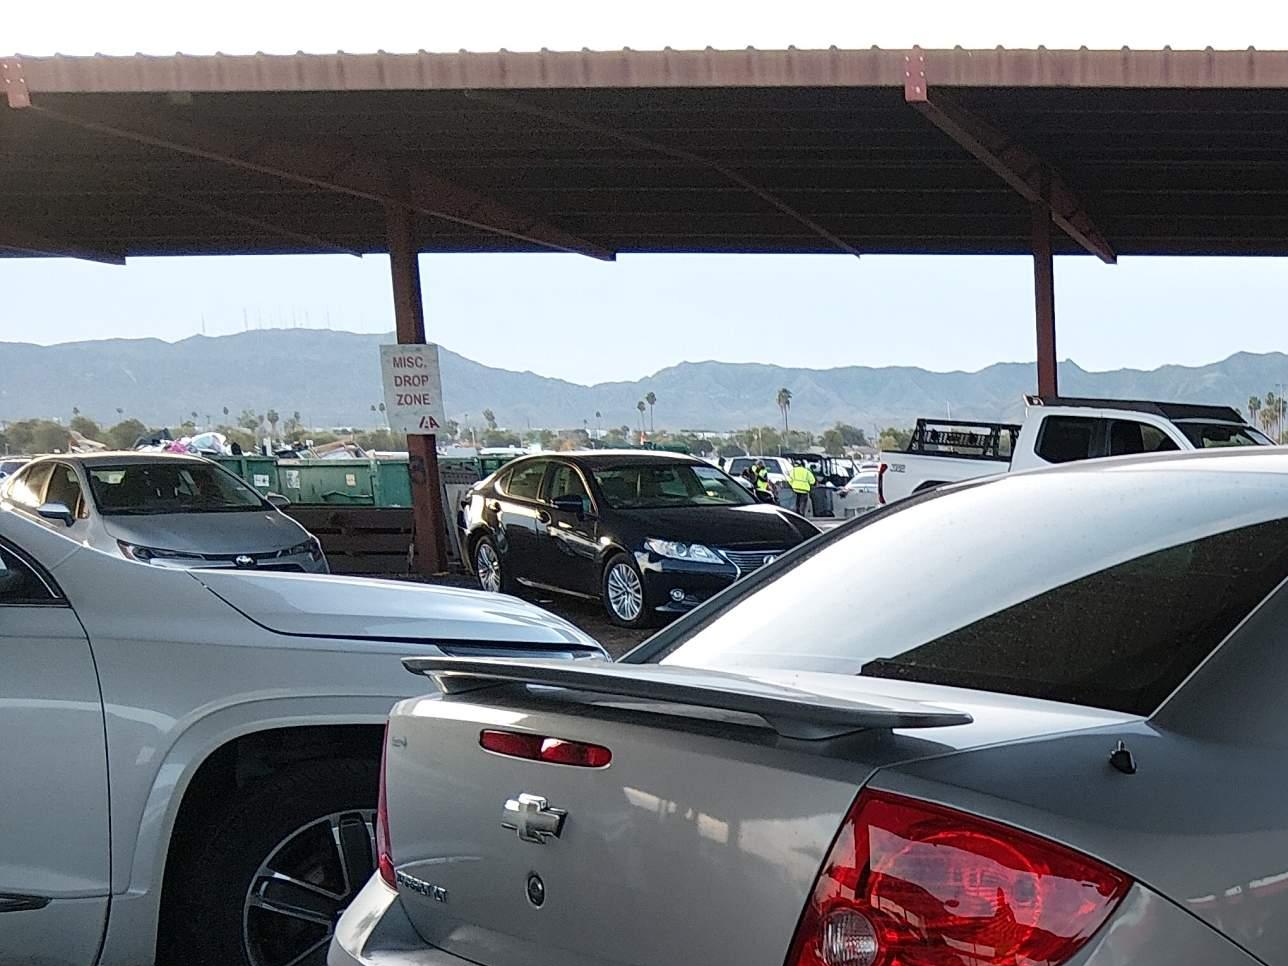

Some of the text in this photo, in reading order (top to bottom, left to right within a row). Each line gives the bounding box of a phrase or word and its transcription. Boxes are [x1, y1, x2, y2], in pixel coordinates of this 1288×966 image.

[392, 356, 427, 368] MISC.
[394, 375, 429, 387] DROP
[396, 393, 431, 406] ZONE
